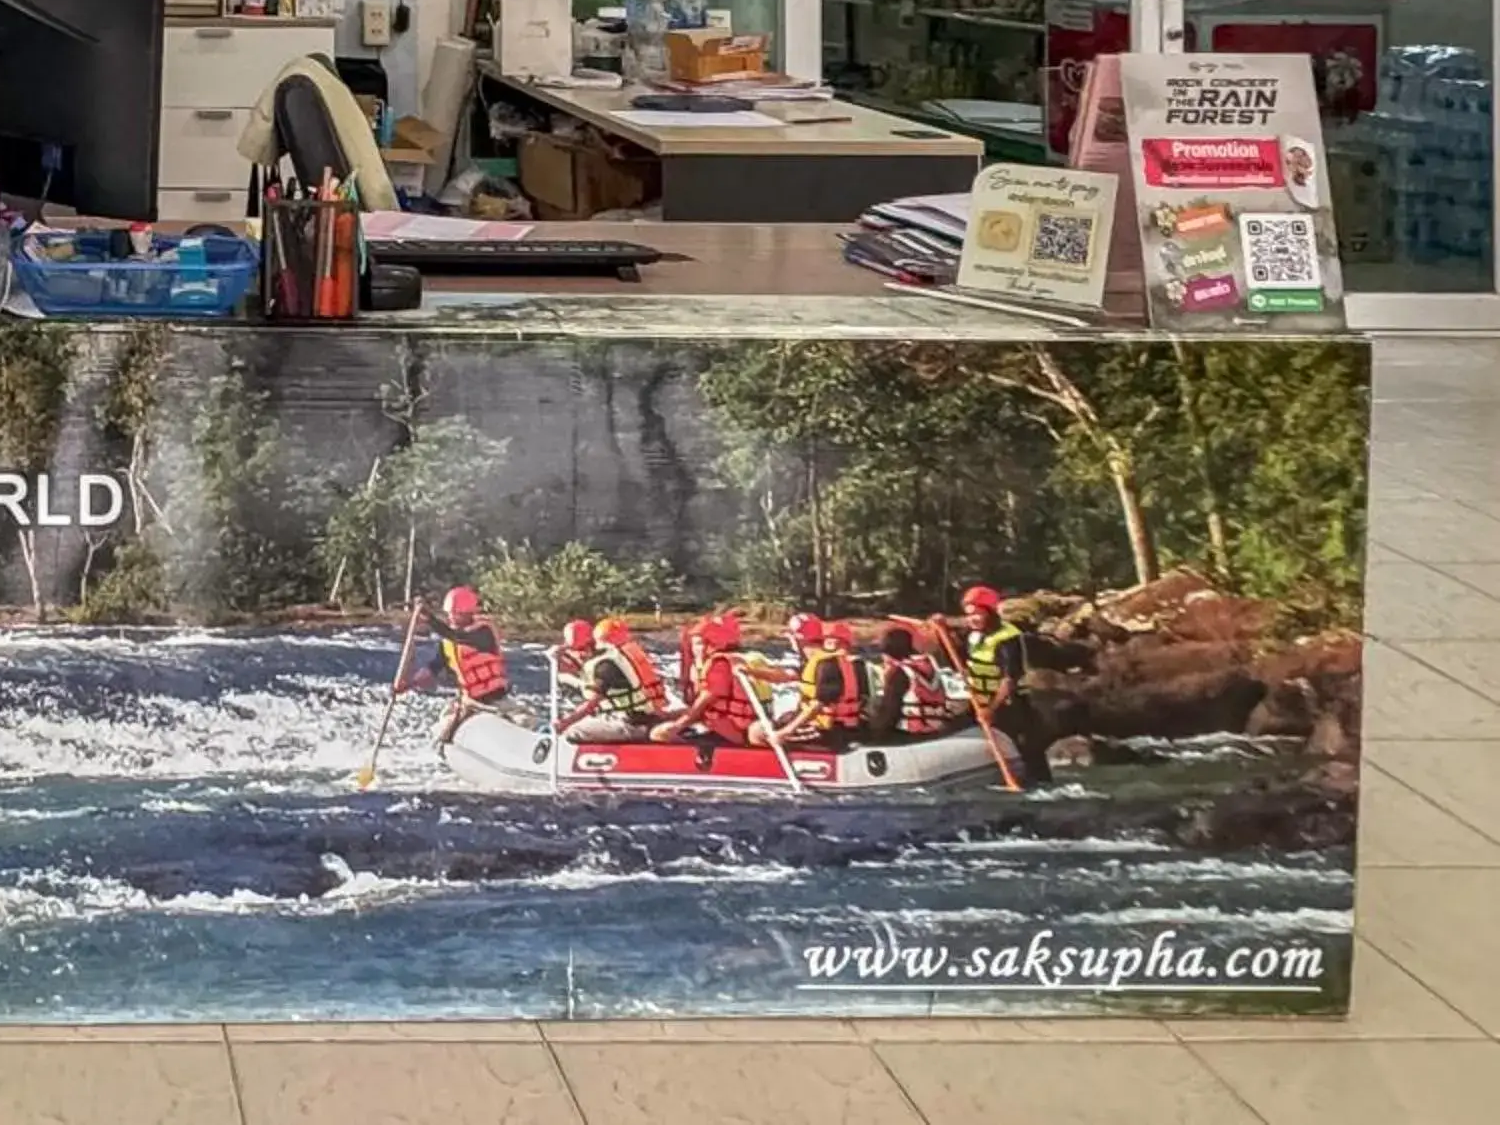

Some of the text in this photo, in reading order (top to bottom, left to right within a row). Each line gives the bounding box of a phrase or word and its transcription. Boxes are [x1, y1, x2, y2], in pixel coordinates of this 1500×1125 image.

[1197, 89, 1278, 108] RAIN
[1165, 108, 1276, 125] FOREST
[1171, 141, 1260, 159] Promotion
[803, 930, 1325, 988] www.saksupha.com
